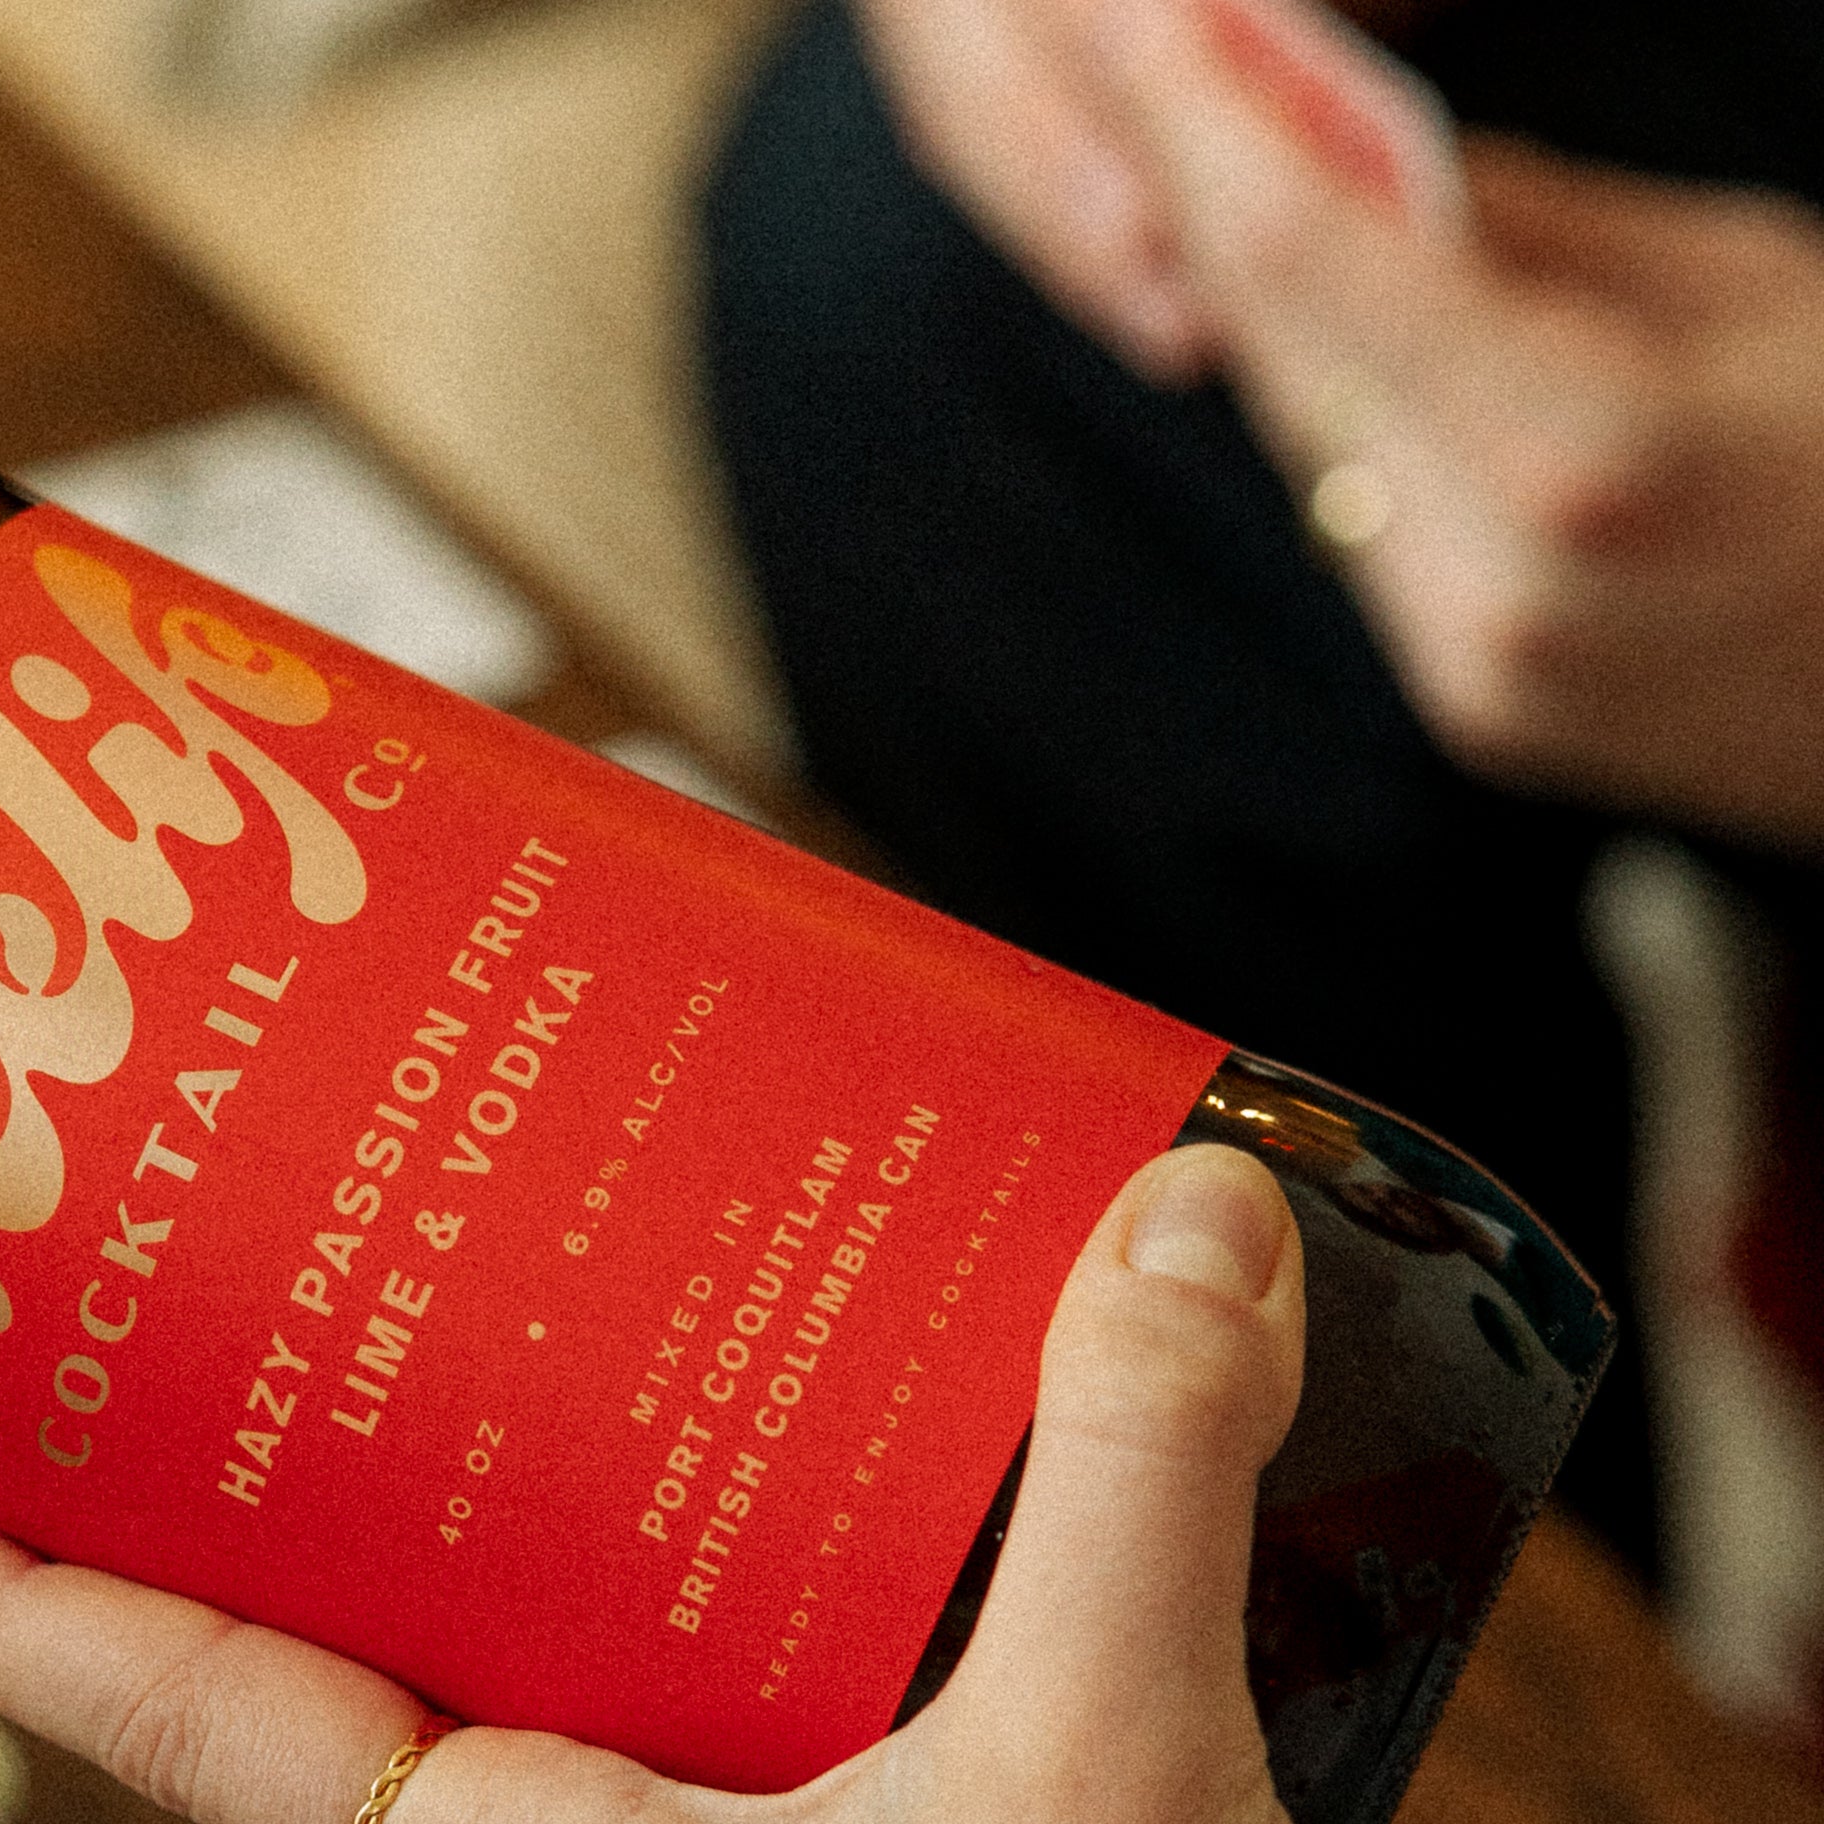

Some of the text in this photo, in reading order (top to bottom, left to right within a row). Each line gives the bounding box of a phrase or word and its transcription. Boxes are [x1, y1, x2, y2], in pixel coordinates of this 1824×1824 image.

[35, 953, 303, 1470] COCKTAIL
[217, 836, 569, 1507] HAZY PASSION FRUIT
[330, 965, 595, 1438] LIME & VODKA
[437, 978, 730, 1546] 40 OZ 6.9% ALC/VOL
[628, 1197, 755, 1426] MIXED IN
[638, 1135, 854, 1543] PORT COQUITLAM
[667, 1103, 942, 1635] BRITISH COLUMBIA CAN
[758, 1130, 1042, 1701] READY TO ENJOY COCKTAILS
